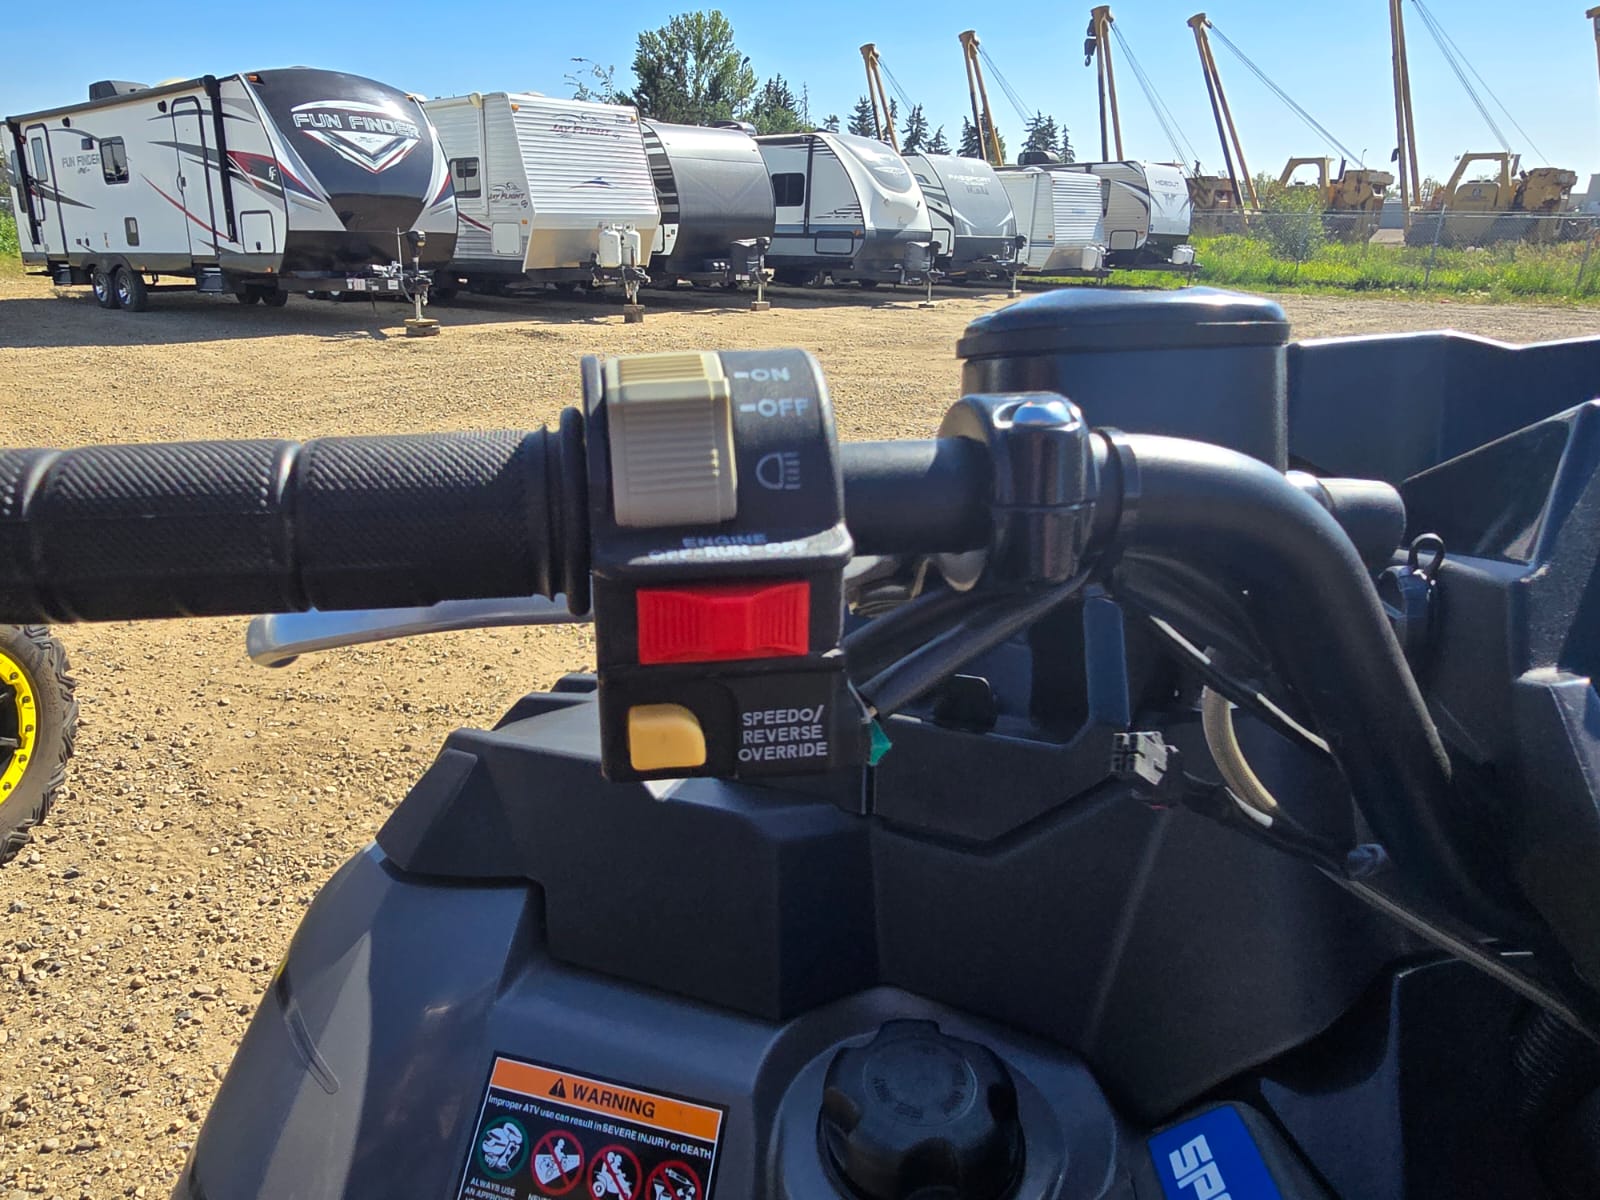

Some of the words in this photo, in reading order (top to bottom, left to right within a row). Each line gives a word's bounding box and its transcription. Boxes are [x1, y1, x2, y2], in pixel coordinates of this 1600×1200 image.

[292, 113, 343, 129] FUN
[348, 115, 420, 138] FINDER
[61, 156, 76, 168] FUN
[681, 533, 768, 548] ENGINE
[742, 704, 825, 726] SPEEDO/
[742, 724, 823, 744] REVERSE
[738, 741, 828, 762] OVERRIDE
[572, 1083, 656, 1119] WARNING
[487, 1094, 522, 1111] Improper
[522, 1103, 541, 1115] ATV
[540, 1108, 555, 1119] use
[554, 1113, 570, 1123] can
[570, 1116, 594, 1129] result
[594, 1120, 602, 1131] in
[601, 1122, 637, 1140] SEVERE
[637, 1132, 671, 1149] INJURY
[670, 1142, 681, 1151] or
[680, 1143, 713, 1160] DEATH
[464, 1186, 477, 1196] AN
[470, 1177, 500, 1193] ALWAYS
[501, 1186, 517, 1197] USE
